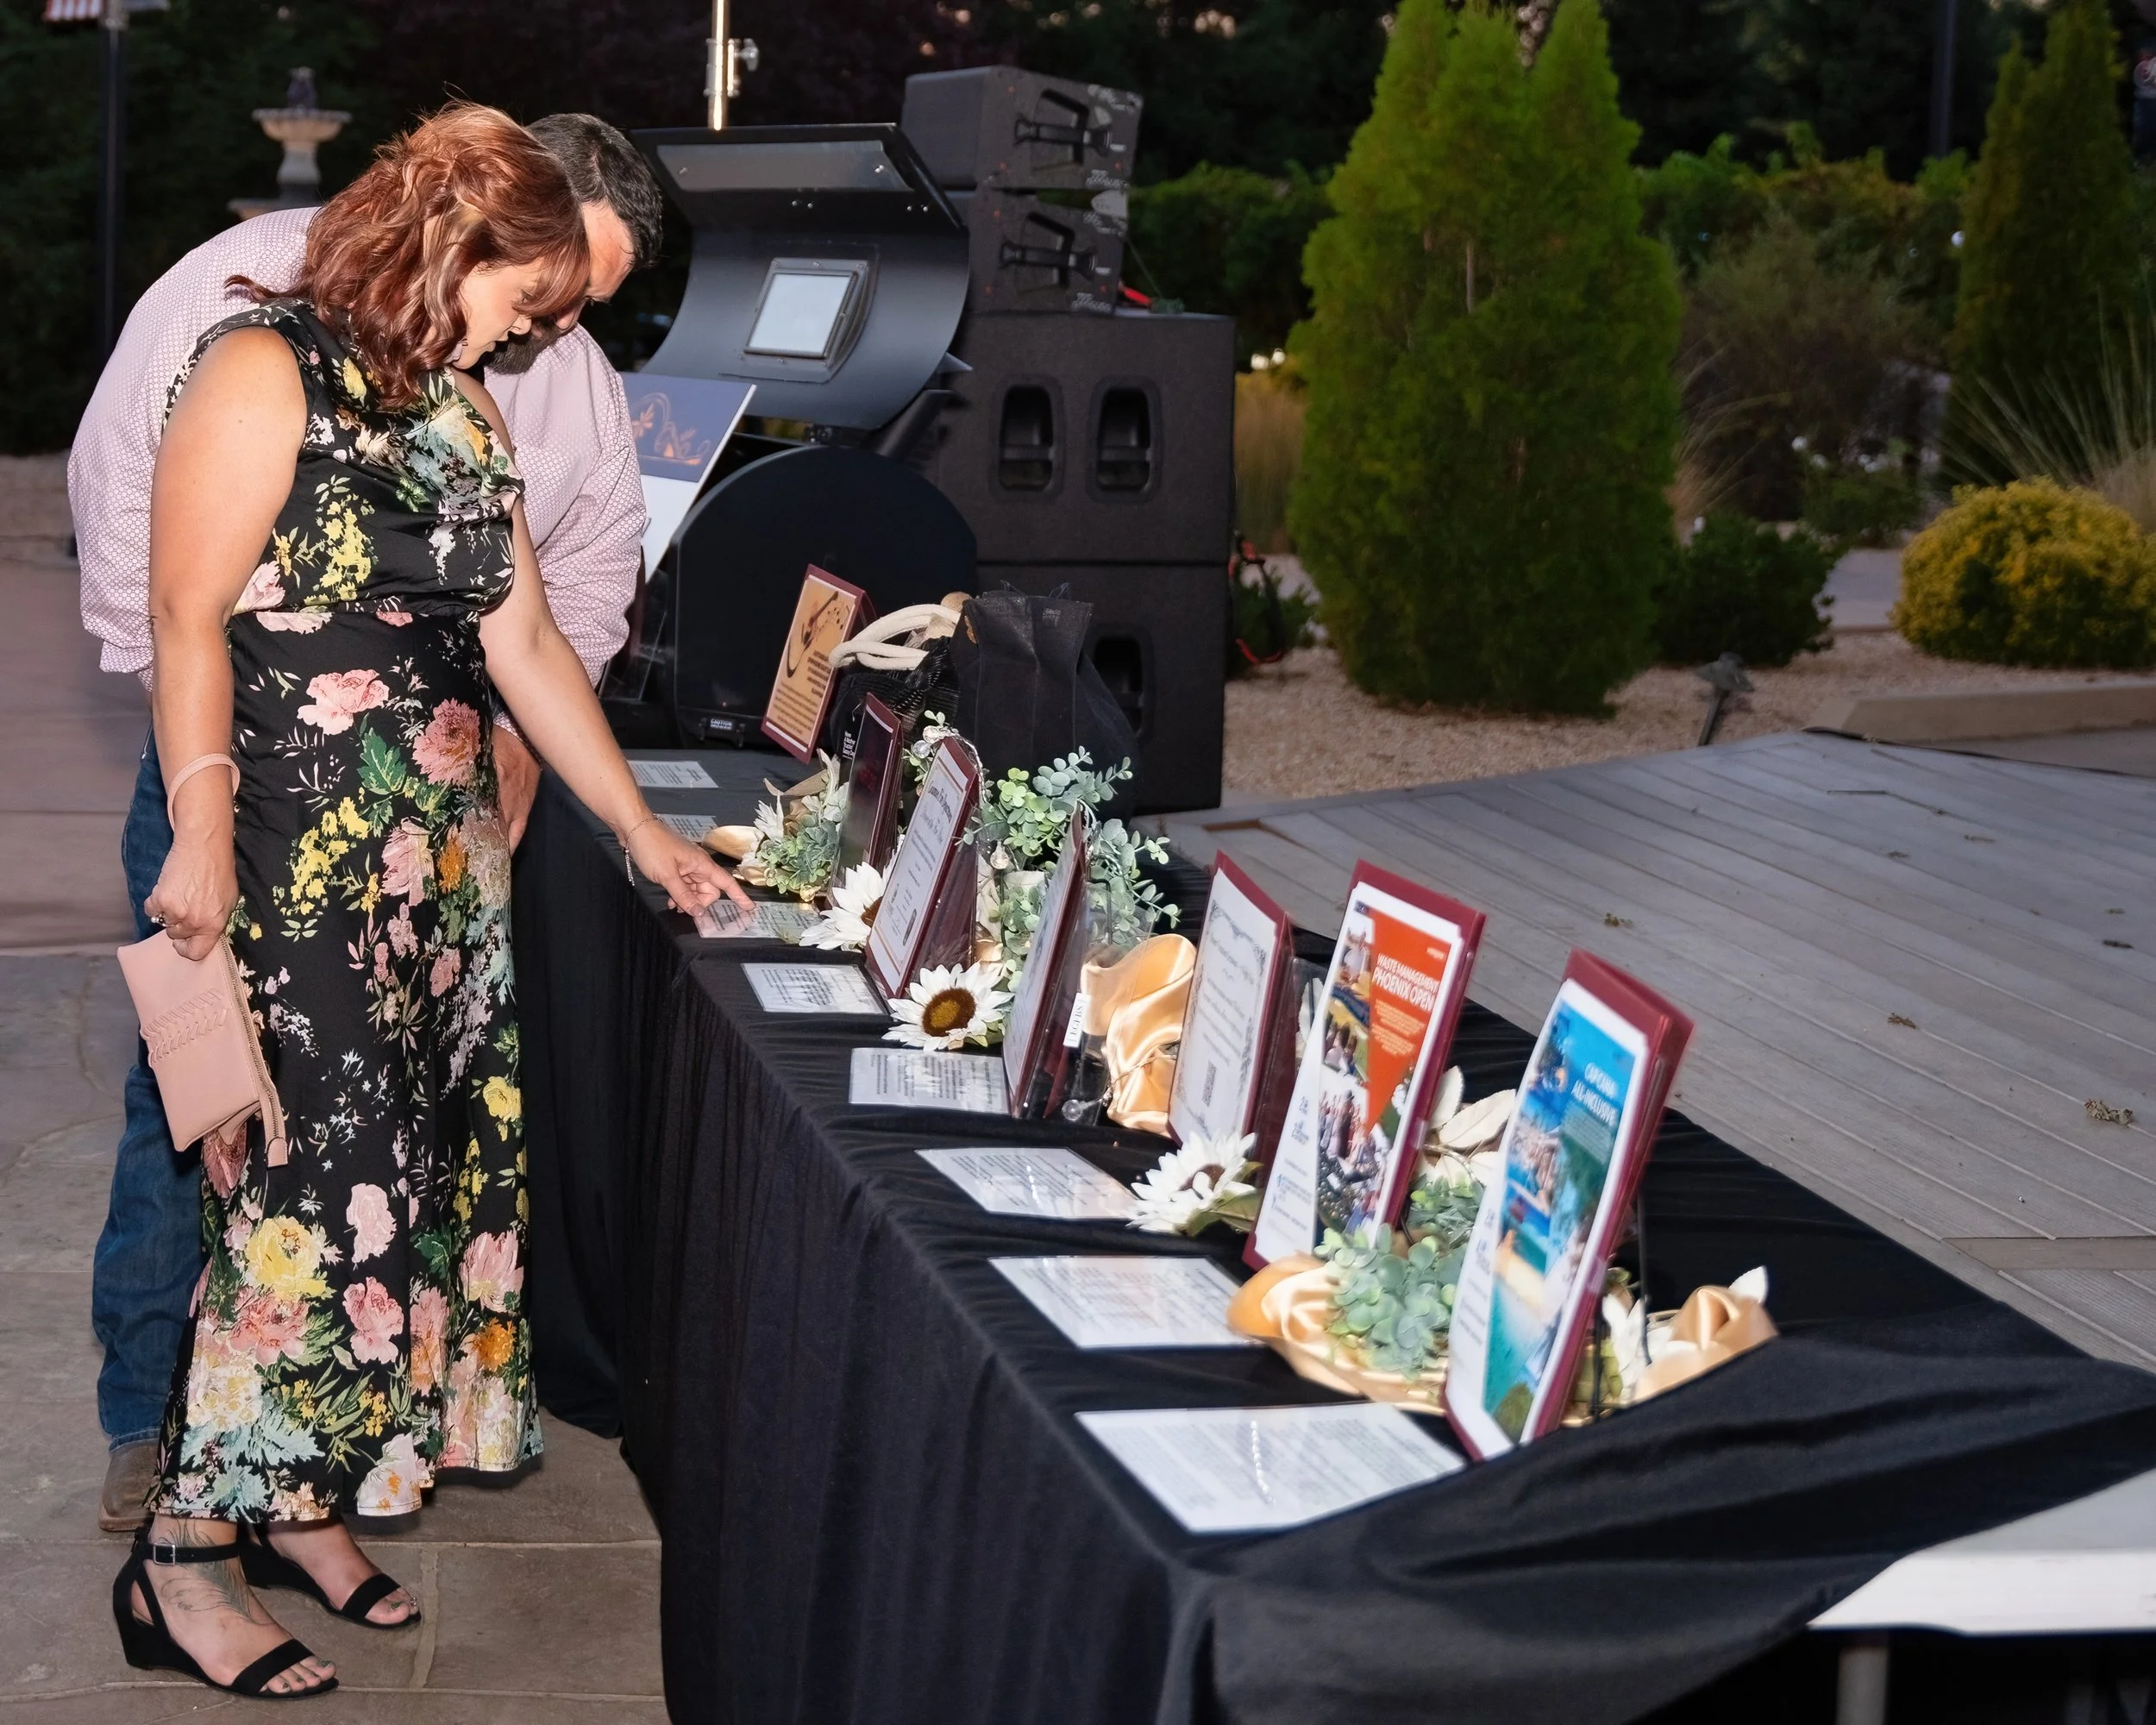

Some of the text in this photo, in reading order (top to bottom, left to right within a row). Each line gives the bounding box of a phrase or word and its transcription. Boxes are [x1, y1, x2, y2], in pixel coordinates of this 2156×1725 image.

[1372, 967, 1436, 1012] PHOENIX OPEN
[1377, 953, 1441, 993] WASTE MANAGEMENT
[1571, 1080, 1618, 1126] ALL-INCLUSIVE
